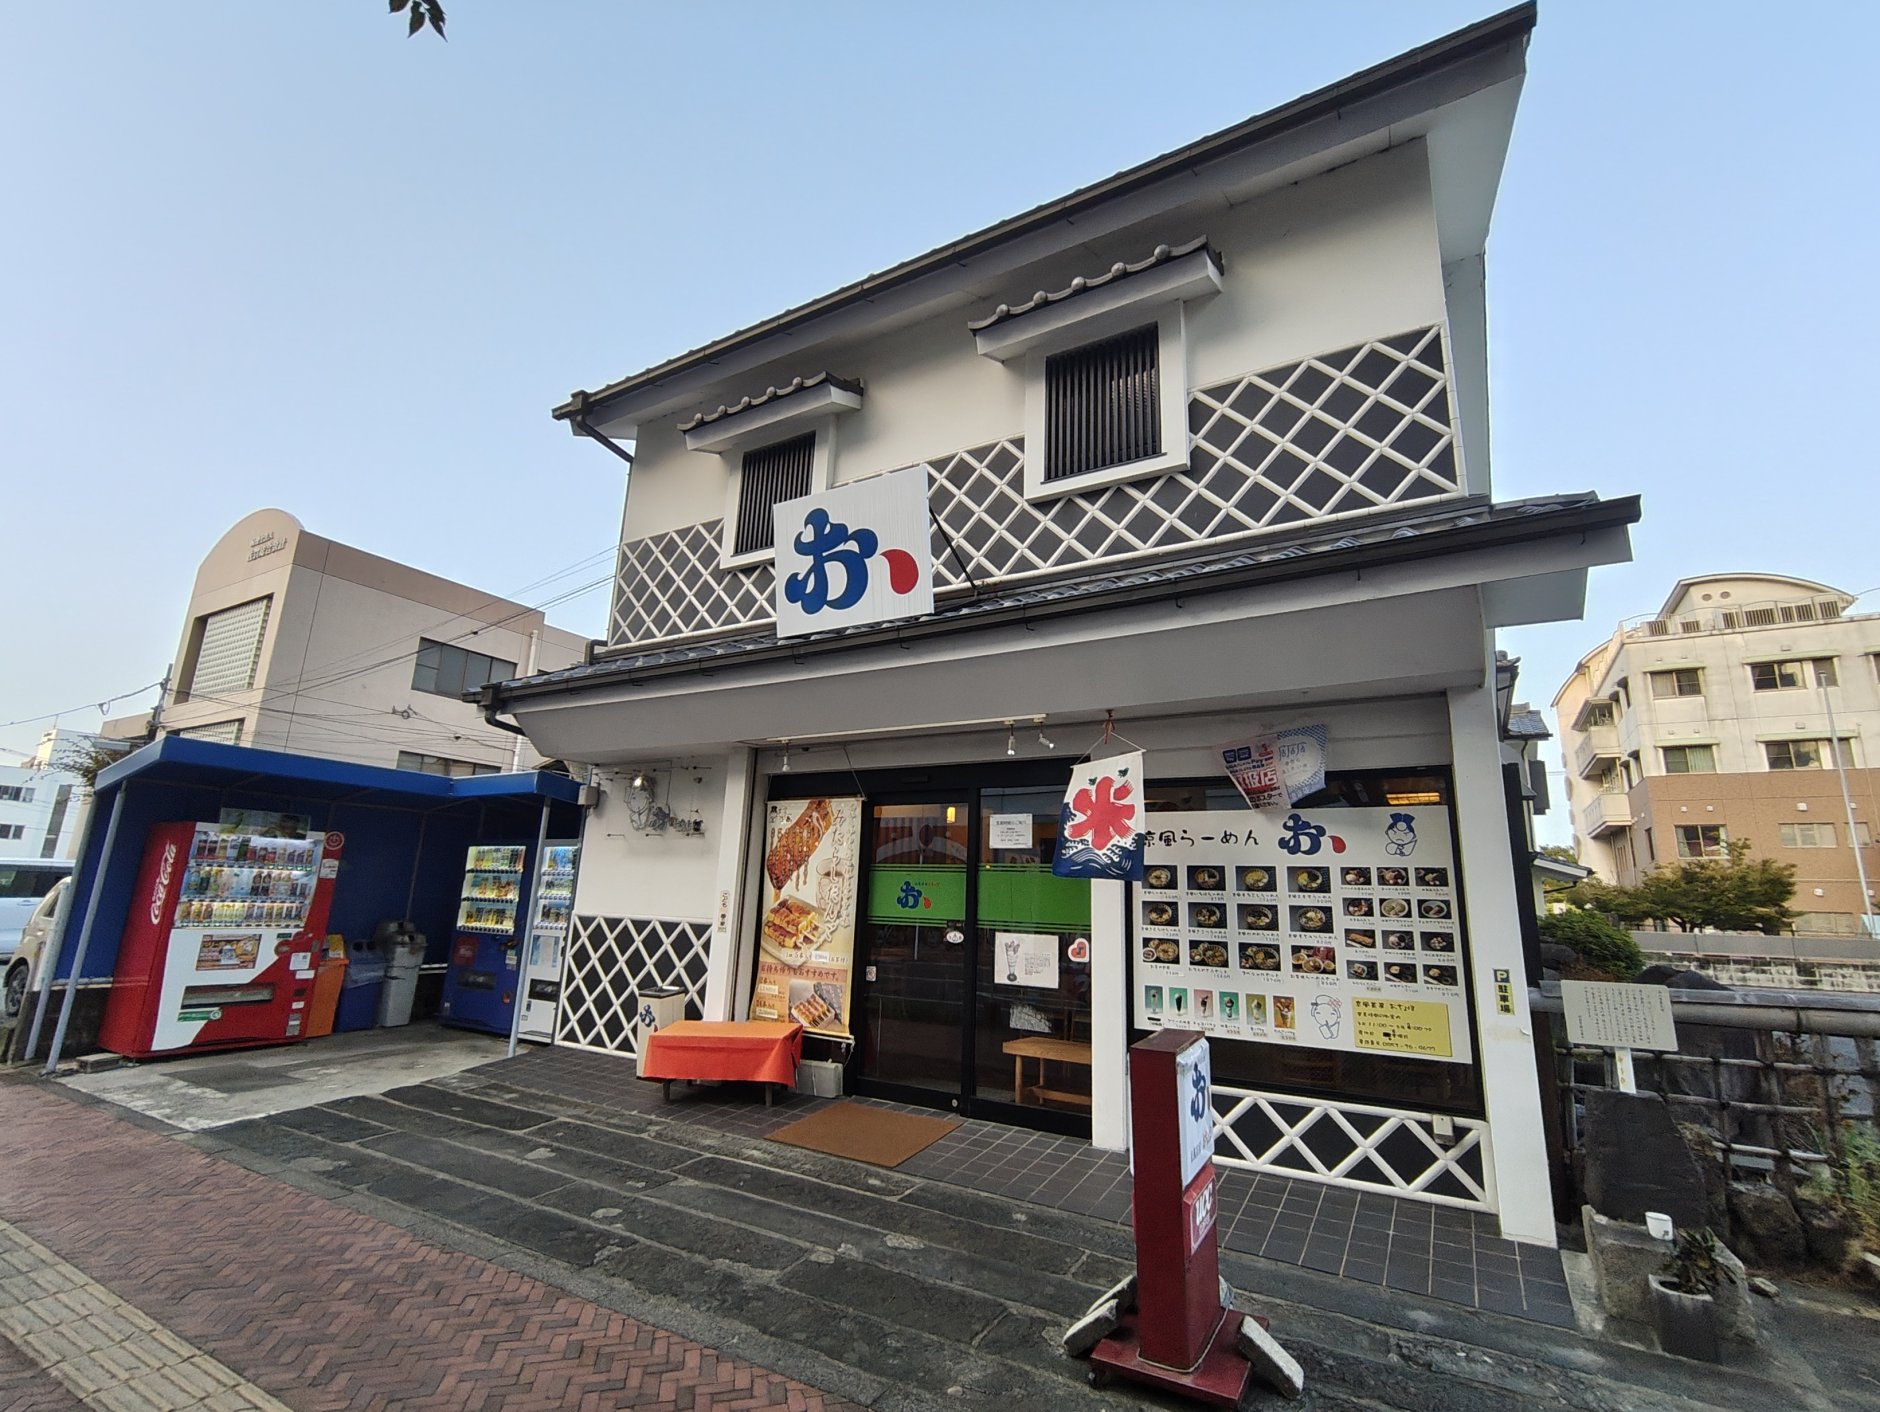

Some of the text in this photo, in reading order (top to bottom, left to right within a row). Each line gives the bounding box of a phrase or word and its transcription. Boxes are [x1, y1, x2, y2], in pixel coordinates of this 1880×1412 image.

[1496, 970, 1508, 982] P
[1498, 984, 1511, 1014] 駐車場
[1196, 1184, 1213, 1226] UCC
